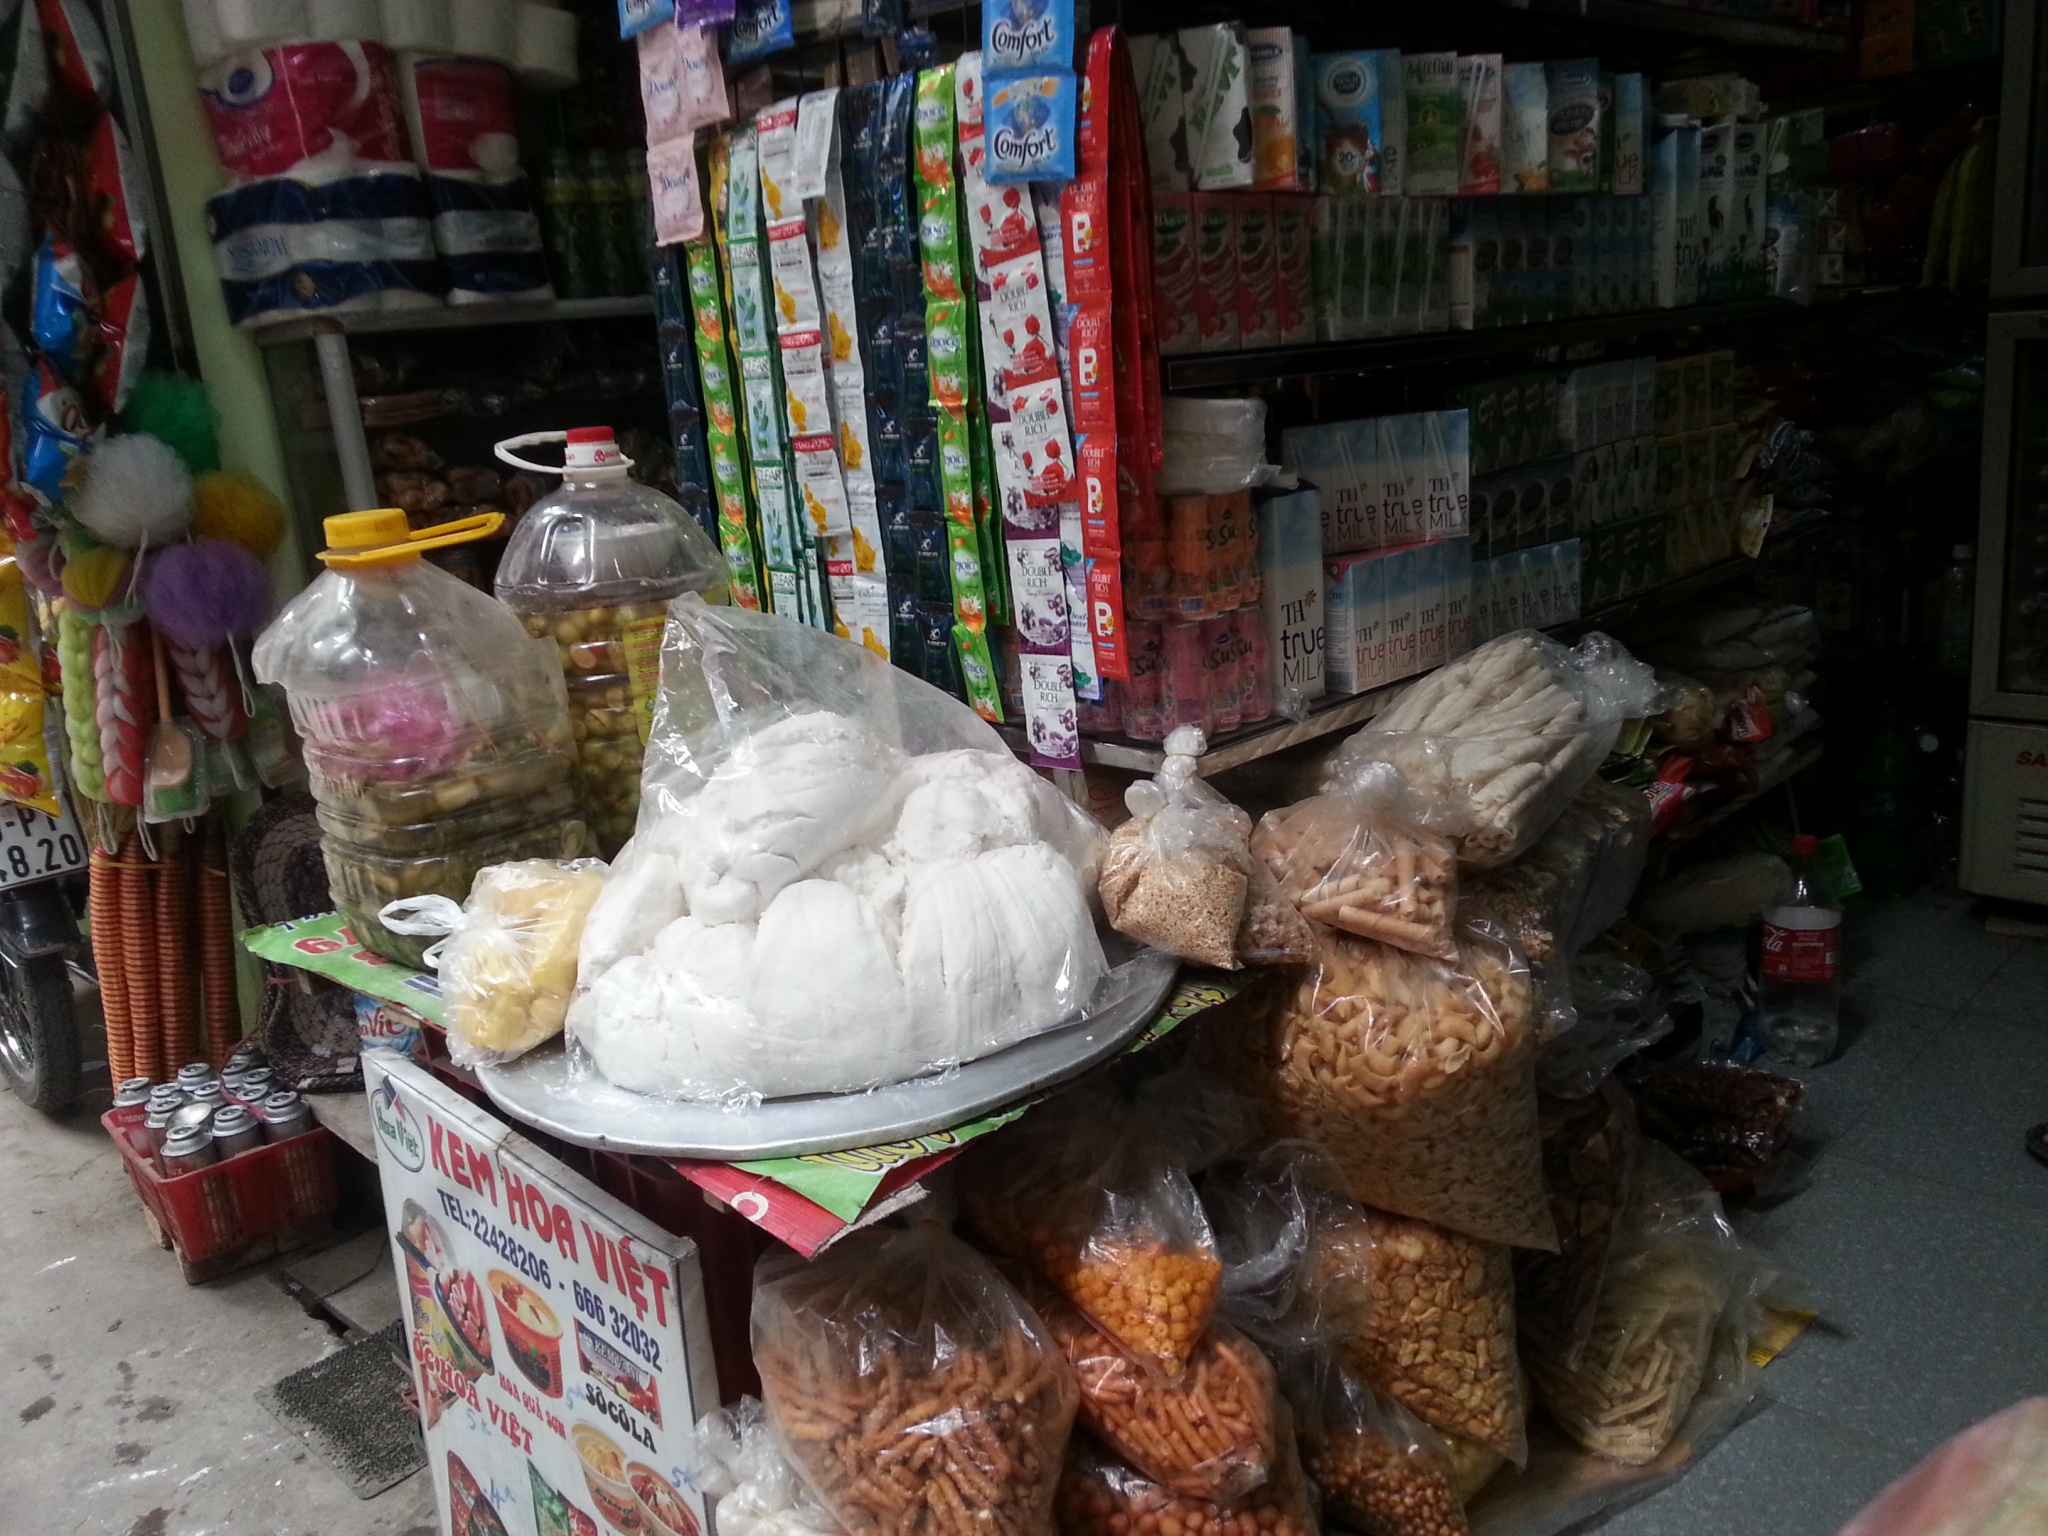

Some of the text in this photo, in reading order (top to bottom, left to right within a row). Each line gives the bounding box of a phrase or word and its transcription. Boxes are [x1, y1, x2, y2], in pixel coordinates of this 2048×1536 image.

[991, 18, 1056, 60] Comfort
[994, 128, 1056, 169] Comfort
[1008, 301, 1028, 314] RICH
[1018, 408, 1050, 426] DOUBLE
[1024, 423, 1048, 437] RICH
[757, 468, 783, 482] CLEAR
[1383, 482, 1404, 498] TH
[1429, 476, 1450, 493] TH
[1336, 488, 1358, 504] TH
[840, 564, 854, 575] 20
[1022, 564, 1053, 577] DOUBLE
[773, 573, 795, 587] CLEAR
[1027, 577, 1049, 589] RICH
[1281, 599, 1306, 626] TH
[1448, 599, 1463, 616] TH
[1419, 608, 1435, 625] TH
[1388, 617, 1404, 634] TH
[1419, 624, 1445, 643] true
[1280, 625, 1324, 661] true
[1356, 627, 1373, 644] TH
[1388, 632, 1416, 652] true
[1356, 642, 1385, 665] true
[1283, 653, 1325, 688] MILK
[1033, 680, 1064, 693] DOUBLE
[1040, 692, 1059, 703] RICH
[2016, 751, 2048, 768] SA
[0, 833, 81, 881] 8.20
[358, 1007, 407, 1038] aVie
[427, 1115, 670, 1327] KEM HOA VIỆT
[573, 1279, 606, 1328] 666
[609, 1304, 663, 1373] 32032
[498, 1370, 521, 1402] HOA
[486, 1397, 533, 1455] VIỆT
